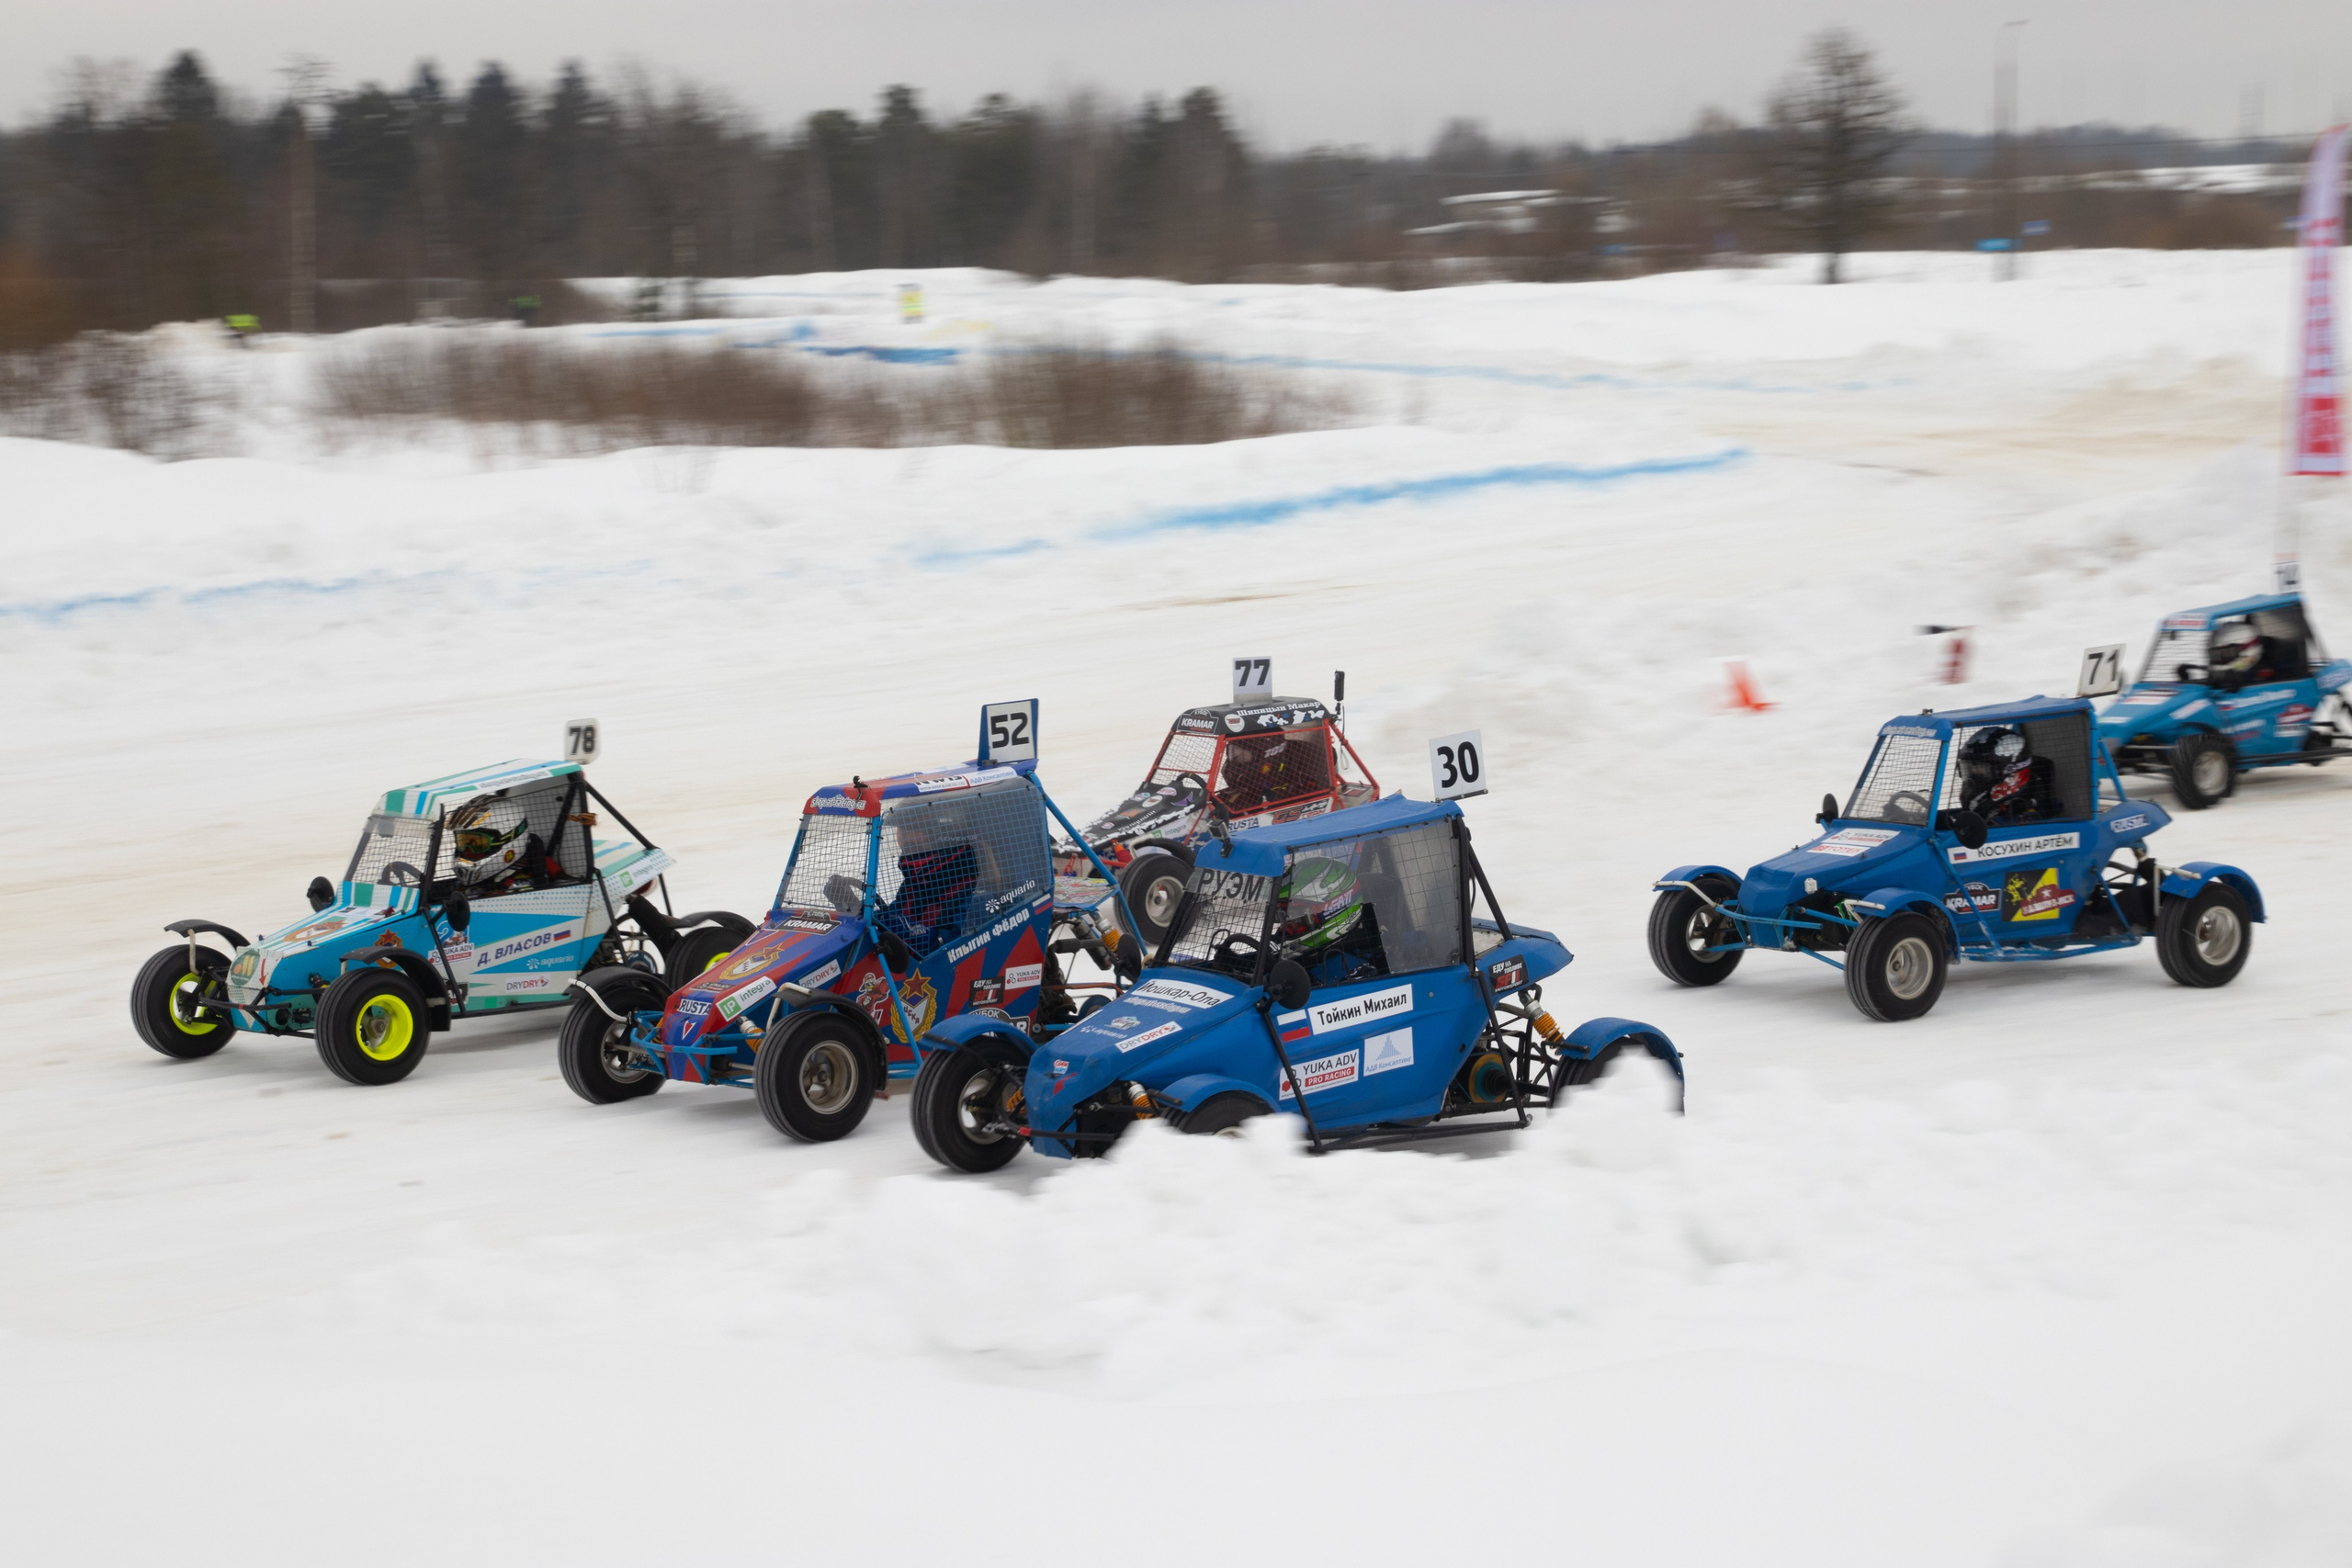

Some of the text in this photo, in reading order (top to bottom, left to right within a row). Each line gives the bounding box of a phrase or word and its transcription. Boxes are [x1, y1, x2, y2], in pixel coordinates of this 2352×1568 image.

[1234, 659, 1271, 687] 77
[2087, 649, 2120, 685] 71
[1237, 701, 1321, 716] Шипицын Макар
[990, 712, 1029, 749] 52
[1181, 717, 1215, 729] KRAMAR
[568, 726, 595, 756] 78
[1437, 740, 1479, 788] 30
[1228, 817, 1260, 831] RUSTA
[1978, 834, 2074, 858] КОСУХИН АРТЁМ
[1001, 880, 1035, 903] aquario
[1197, 868, 1265, 902] РУЭМ
[784, 919, 832, 931] KRAMAR
[992, 908, 1030, 937] Фёдор
[477, 932, 551, 966] Д. ВЛАСОВ
[540, 953, 574, 968] aquario
[1492, 963, 1505, 974] ЕДУ
[506, 977, 540, 991] DRYDRY
[801, 969, 831, 987] DRYDRY
[974, 979, 986, 988] ЕДУ
[740, 979, 771, 1002] integra
[1137, 980, 1221, 1006] Йошкар-Ола
[679, 999, 711, 1014] RUSTA
[723, 1000, 736, 1014] IP
[1317, 993, 1407, 1026] Тойкин Михаил
[1119, 1027, 1164, 1049] DRYDRY
[1303, 1052, 1357, 1075] YUKA ADV
[1365, 1056, 1411, 1074] АДВ Консалтинг
[1307, 1068, 1351, 1086] PRO RACING
